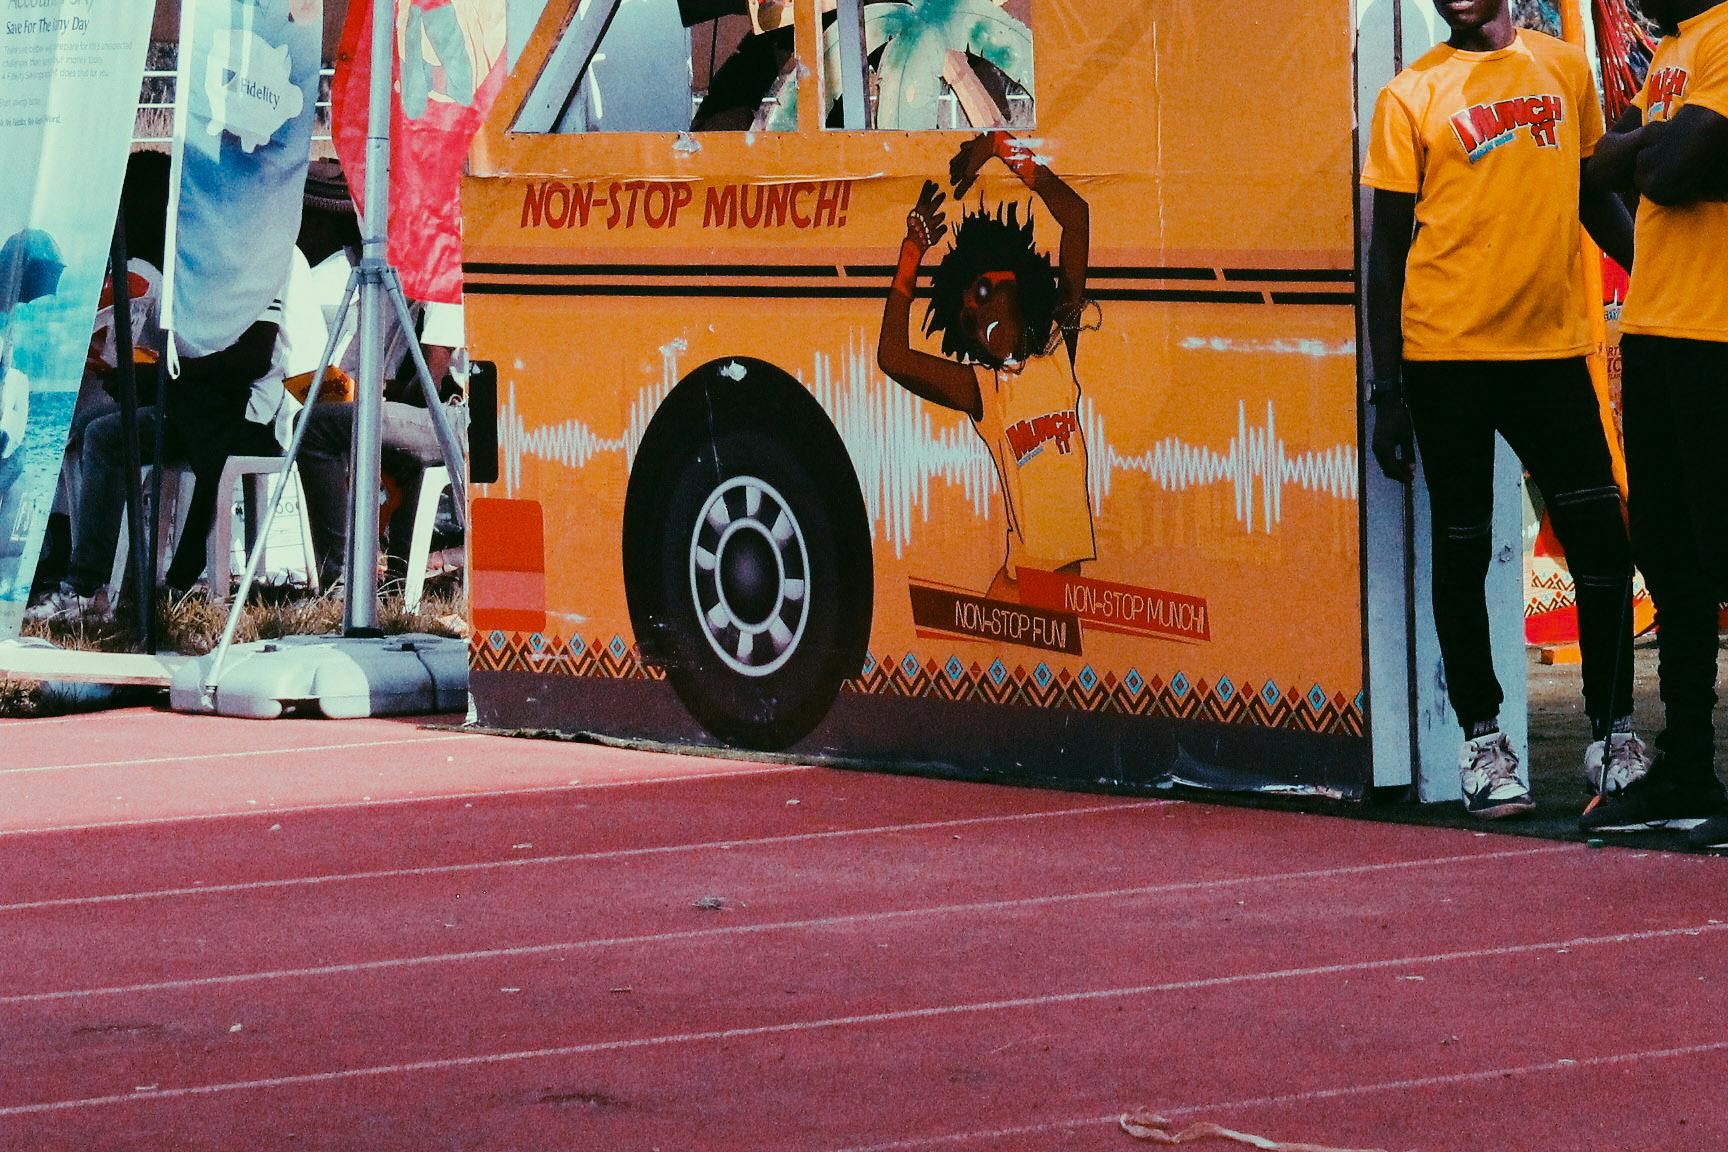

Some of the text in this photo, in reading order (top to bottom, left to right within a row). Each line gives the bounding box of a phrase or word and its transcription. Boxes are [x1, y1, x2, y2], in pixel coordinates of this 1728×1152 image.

[23, 19, 37, 34] For
[72, 16, 90, 36] Day
[240, 78, 281, 110] Fidelity
[1449, 94, 1563, 154] MUNCH
[520, 179, 849, 230] NON-STOP MUNCH!
[1006, 410, 1077, 461] MUNCH
[953, 598, 1068, 649] NON-STOP FUN!
[1065, 583, 1205, 635] NON-STOP MUNCH!
